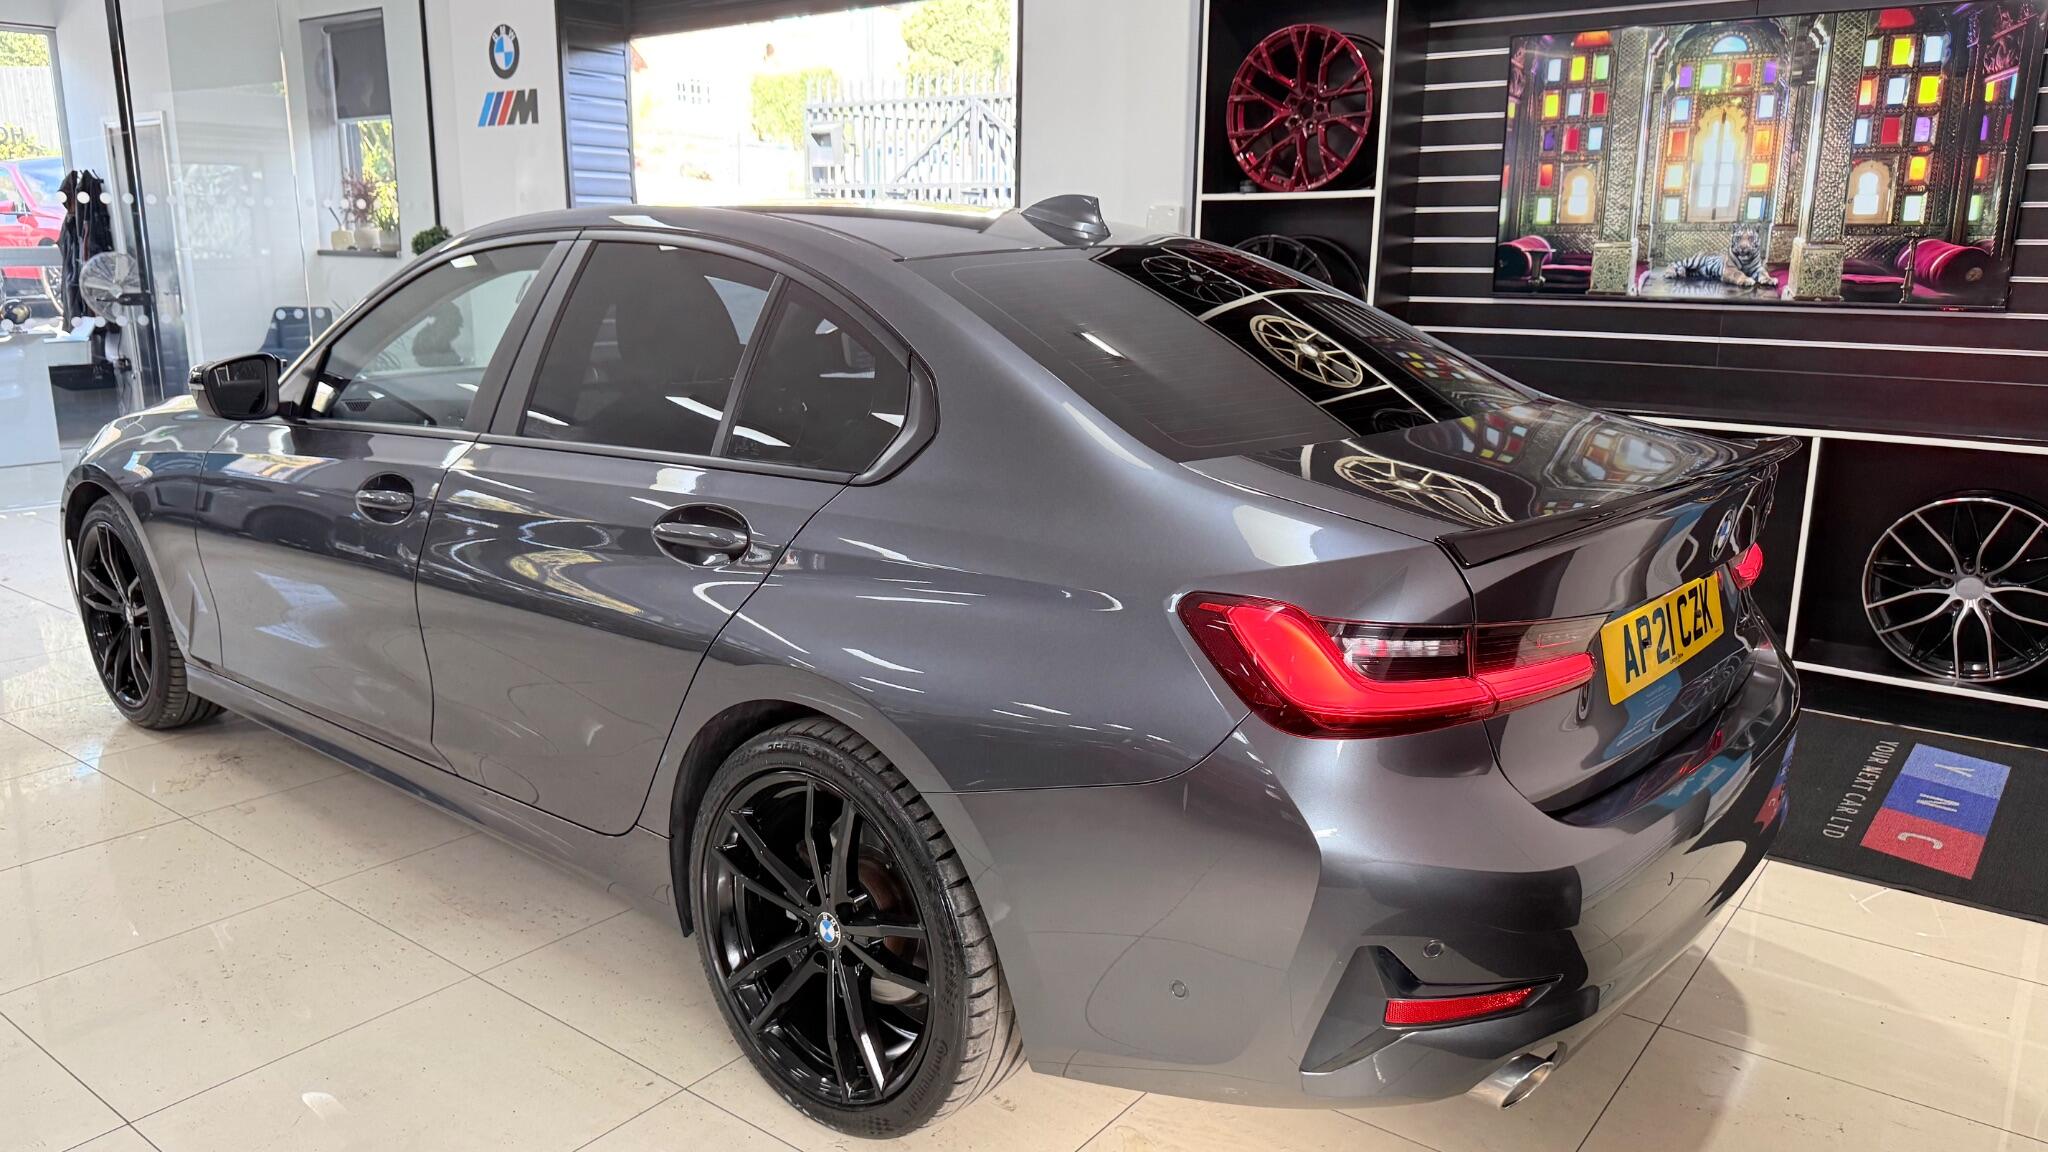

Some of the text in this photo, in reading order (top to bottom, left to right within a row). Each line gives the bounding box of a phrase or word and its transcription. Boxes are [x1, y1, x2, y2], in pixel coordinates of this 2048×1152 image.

[1623, 579, 1714, 684] AP21 CZK
[1823, 740, 1899, 838] YOUR NEXT CAR LTD
